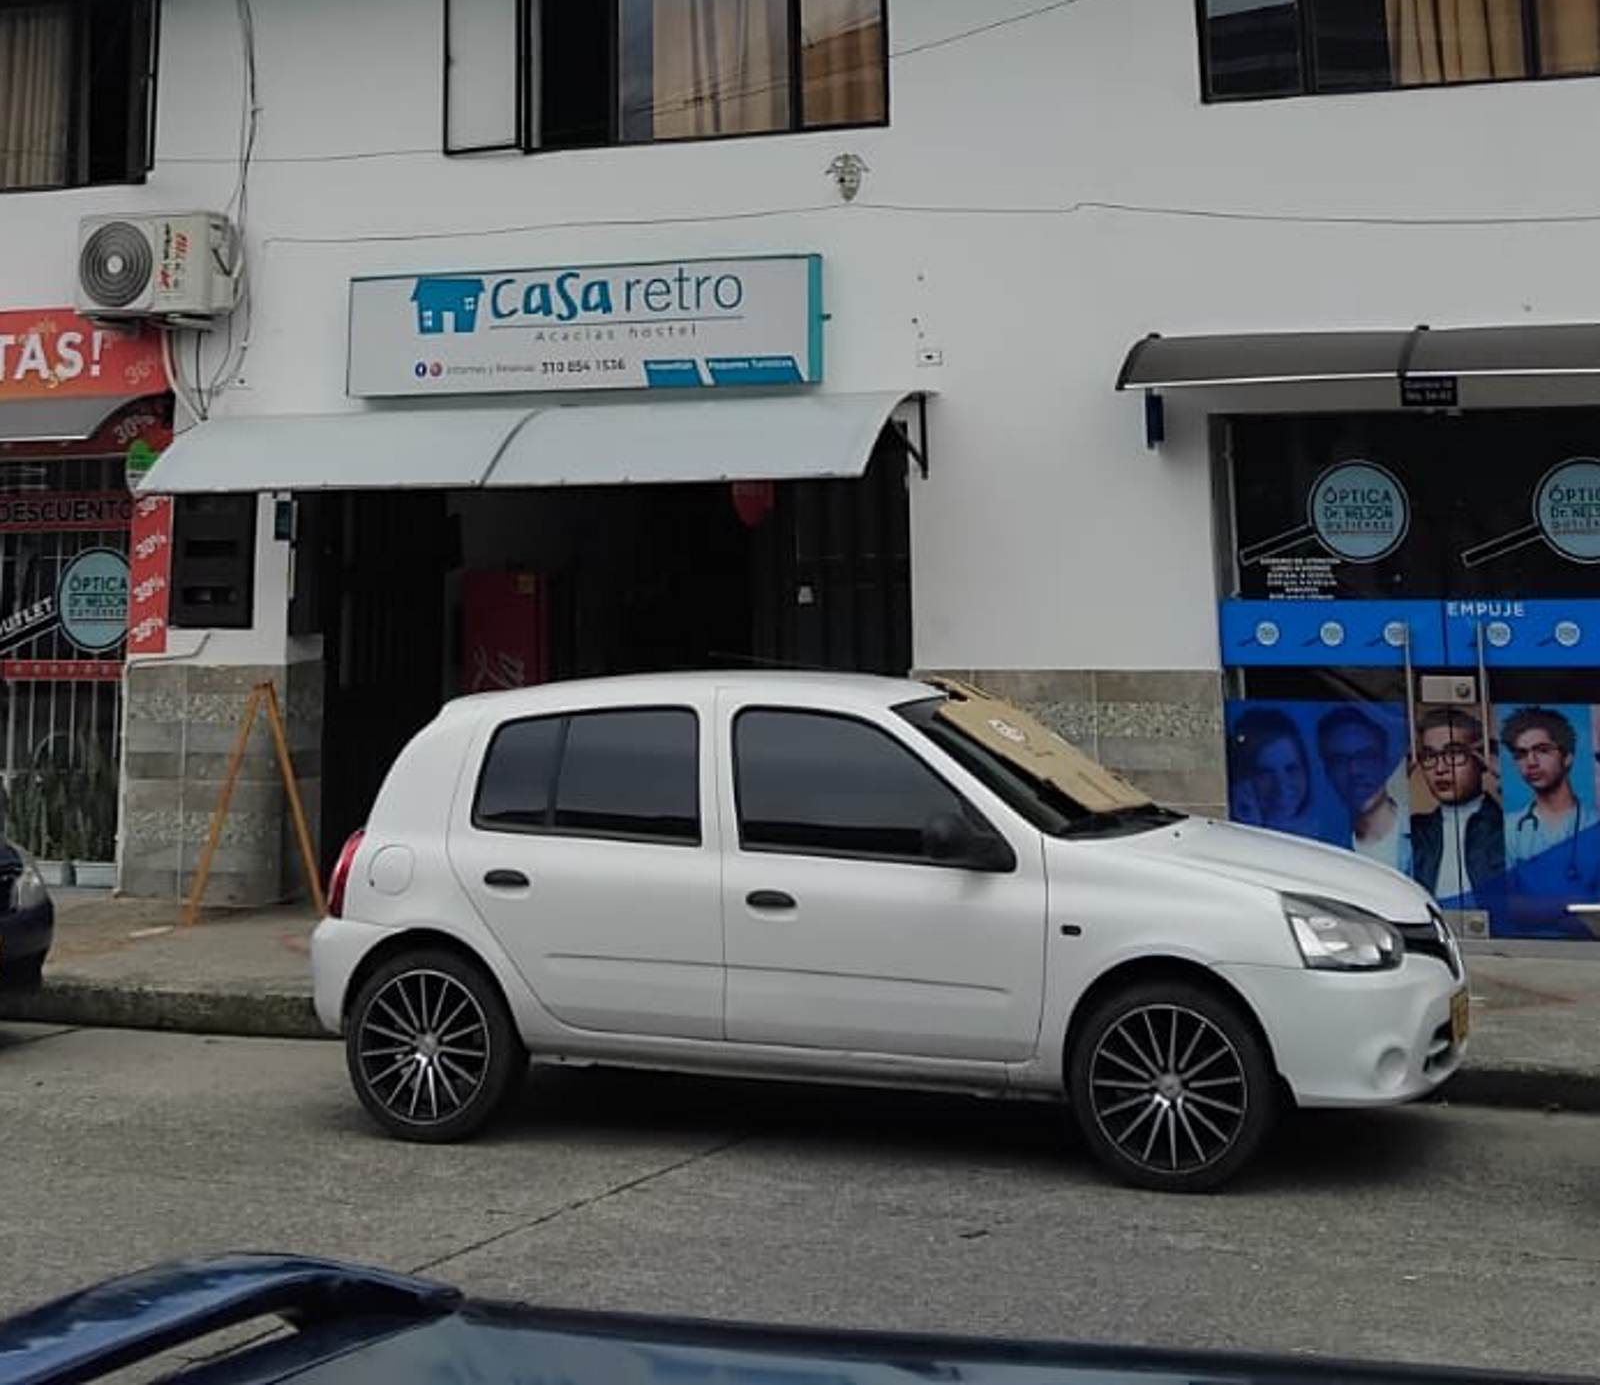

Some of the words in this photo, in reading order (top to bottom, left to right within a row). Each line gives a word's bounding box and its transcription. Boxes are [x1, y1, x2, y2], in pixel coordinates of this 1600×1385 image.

[625, 267, 743, 313] retro
[628, 323, 698, 339] hostel
[1323, 485, 1393, 504] ÓPTICA
[0, 595, 53, 634] UTLET
[1446, 601, 1525, 617] EMPUJE
